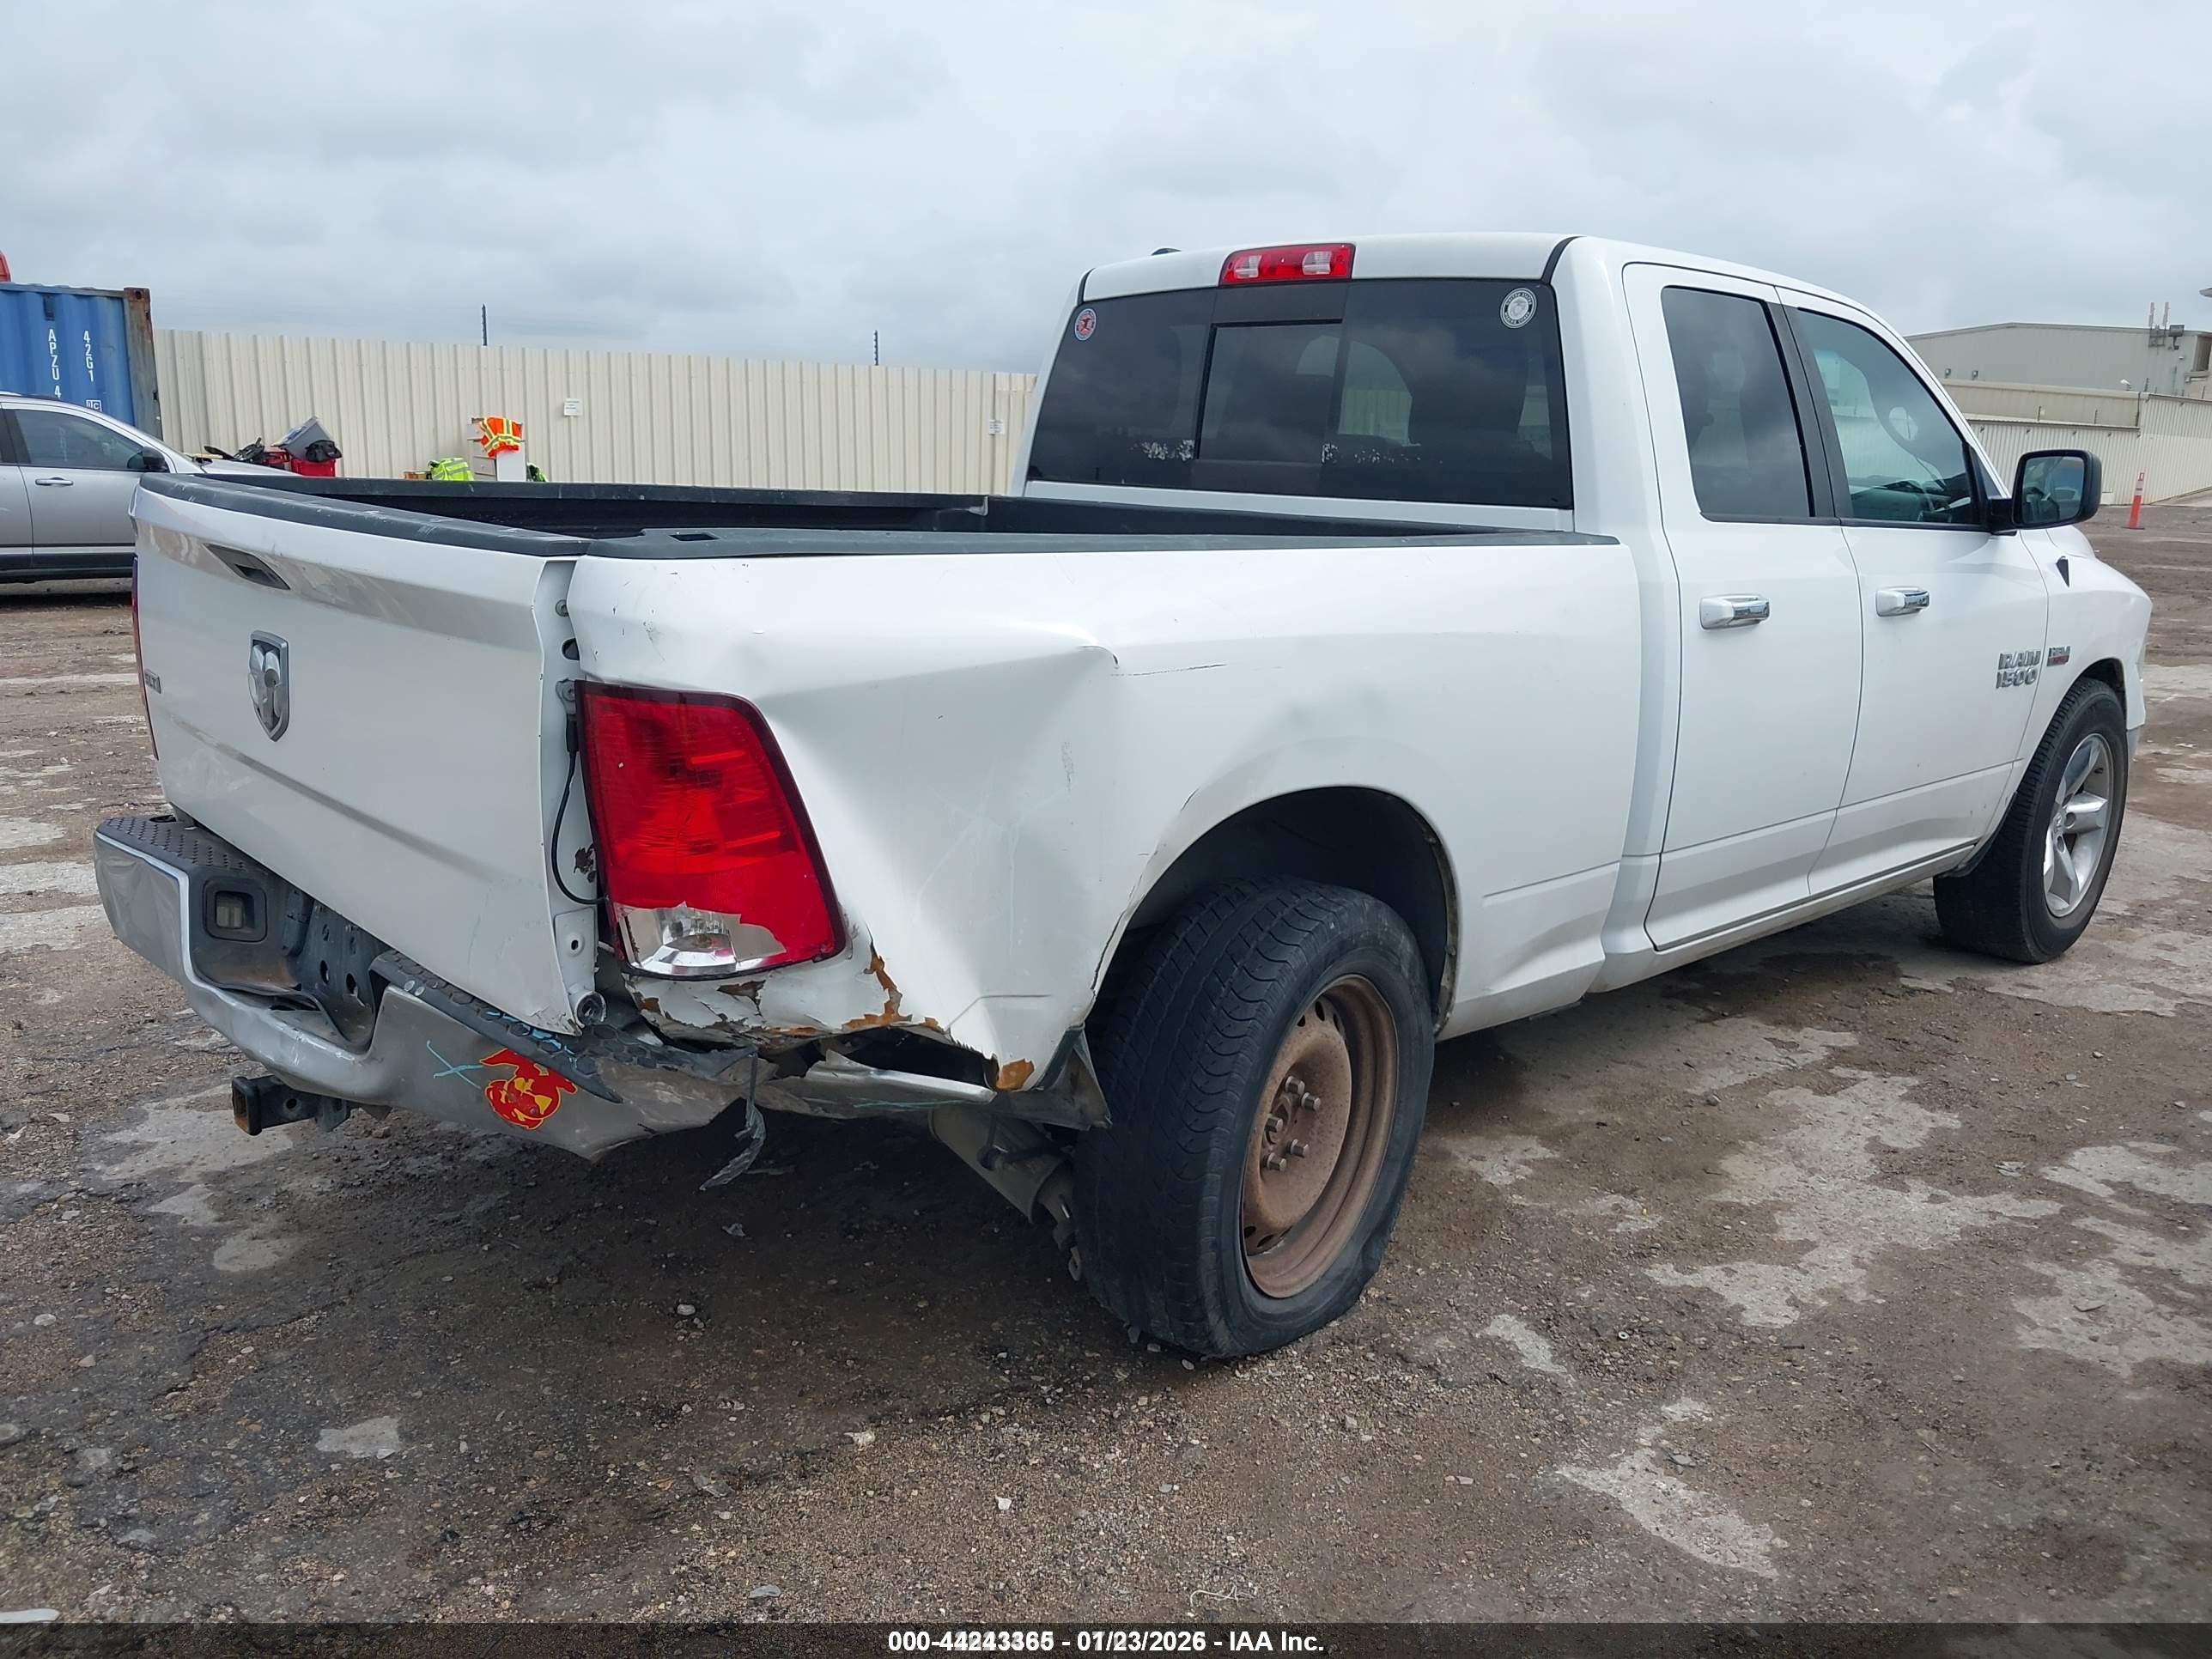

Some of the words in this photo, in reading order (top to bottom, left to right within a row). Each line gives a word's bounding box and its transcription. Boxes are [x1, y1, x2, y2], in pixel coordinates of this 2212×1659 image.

[48, 329, 60, 380] APZU
[83, 330, 94, 383] 42G1
[1996, 667, 2038, 689] 1500
